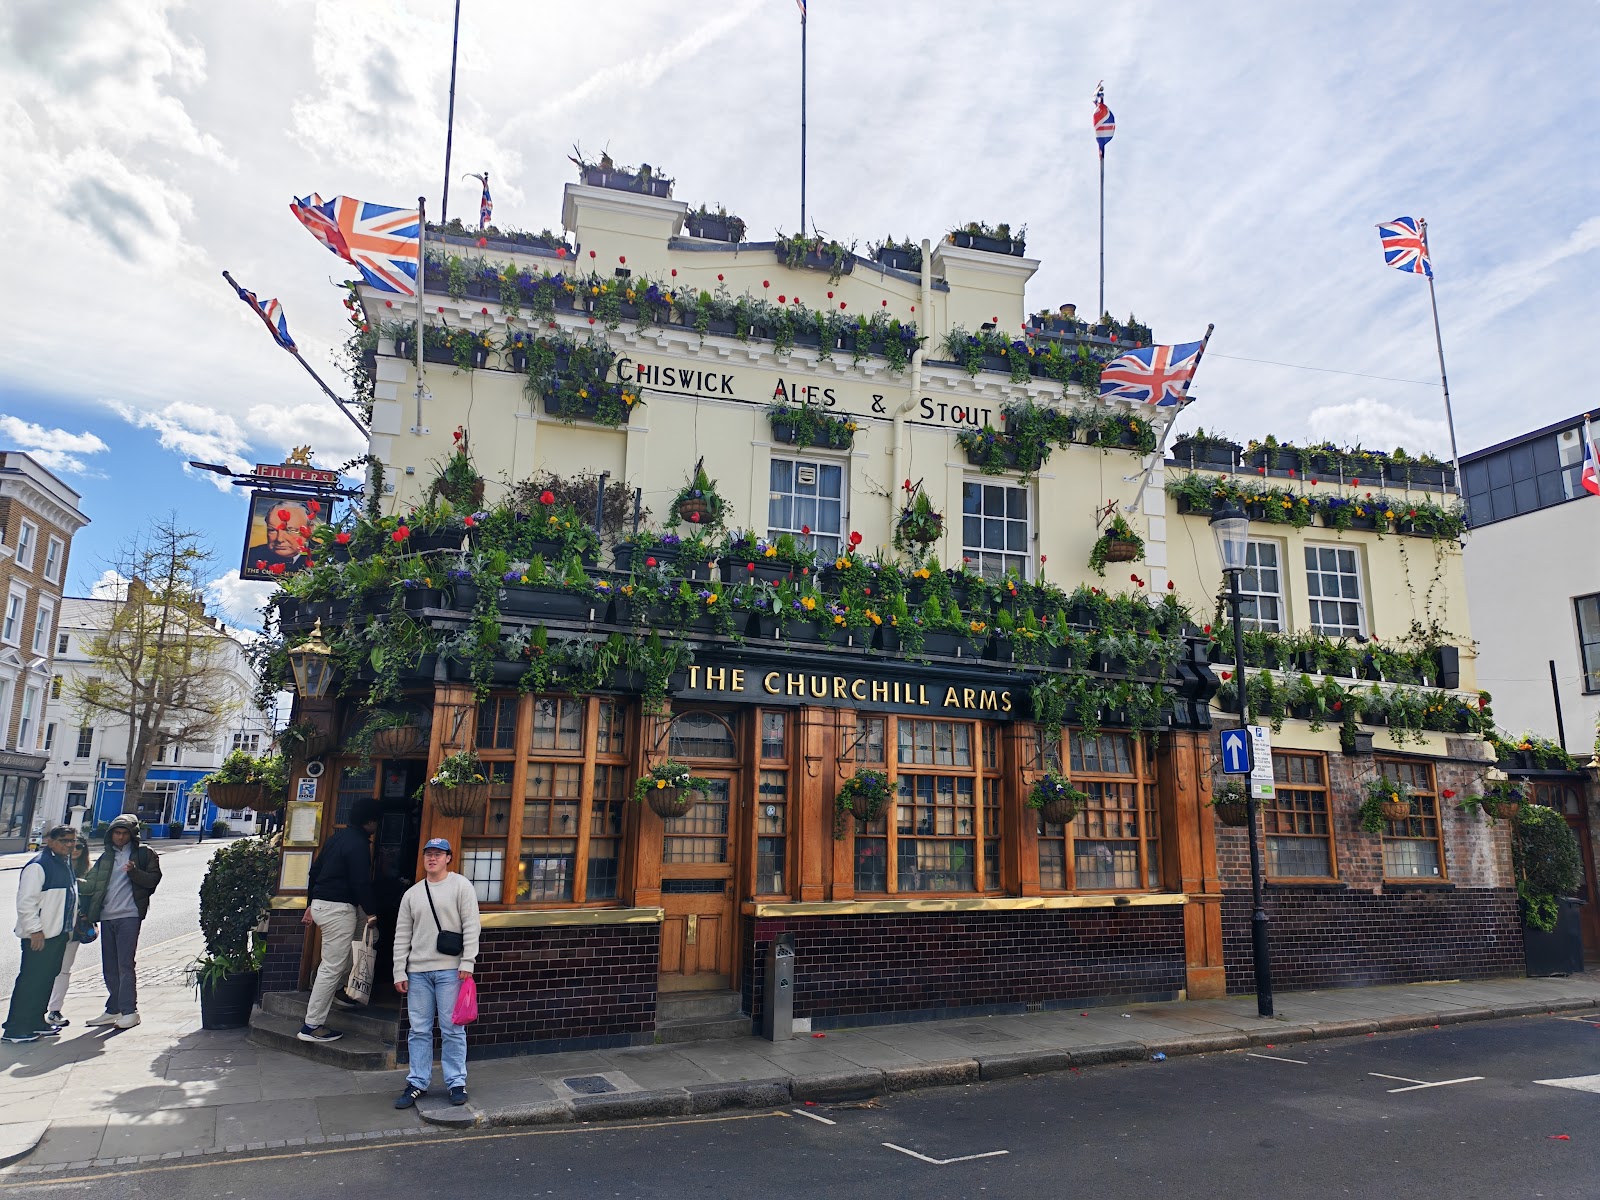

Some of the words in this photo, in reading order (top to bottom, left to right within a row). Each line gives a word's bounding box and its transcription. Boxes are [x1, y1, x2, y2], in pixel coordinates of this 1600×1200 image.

[617, 358, 735, 394] CHISWICK
[772, 378, 836, 407] ALES
[871, 394, 887, 414] &
[920, 397, 992, 427] STOUT
[261, 466, 331, 481] FULLER'S
[687, 665, 745, 693] THE
[763, 671, 930, 706] CHURCHILL
[943, 685, 1013, 712] ARMS
